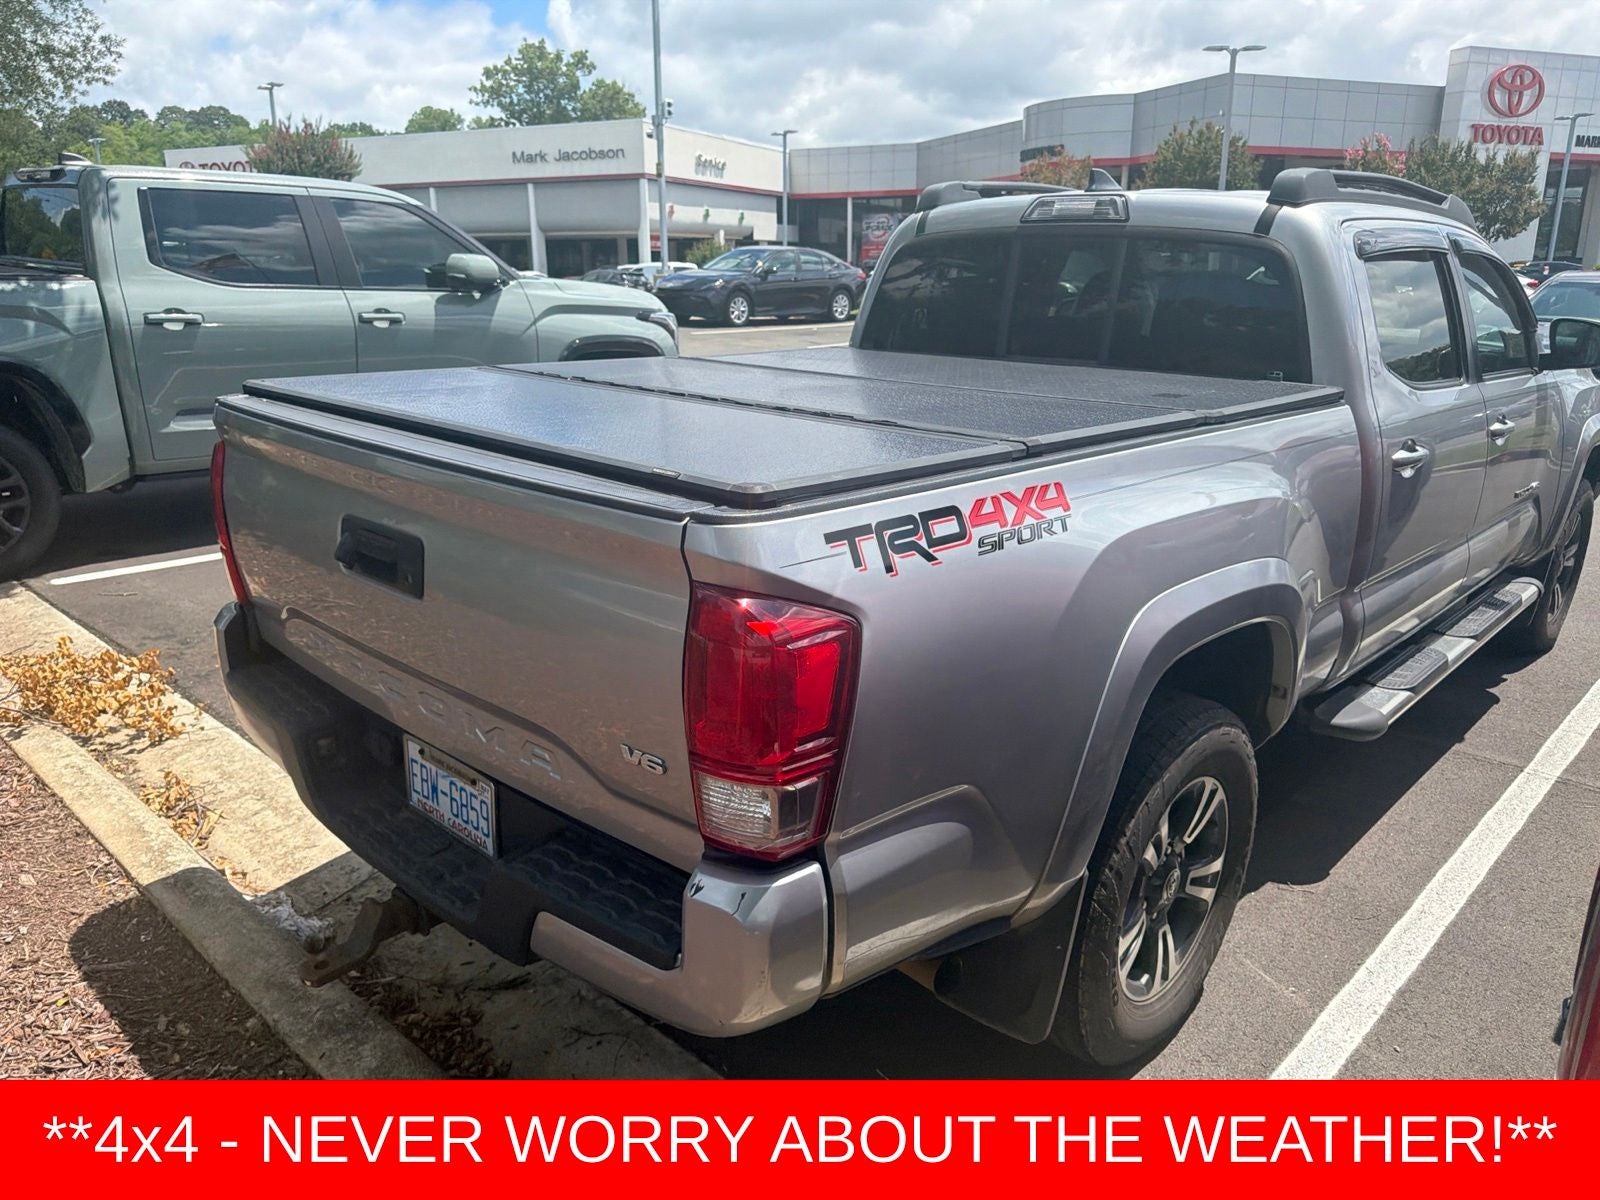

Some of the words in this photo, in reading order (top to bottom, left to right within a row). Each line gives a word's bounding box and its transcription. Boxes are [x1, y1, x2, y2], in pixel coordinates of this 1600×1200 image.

[1471, 123, 1544, 145] TOYOTA
[198, 161, 253, 172] TOYOT
[512, 150, 548, 163] Mark
[554, 147, 625, 162] Jacobson
[823, 505, 973, 577] TRD
[968, 481, 1072, 529] 4X4
[977, 514, 1072, 557] SPORT
[620, 743, 667, 775] V6
[410, 758, 490, 838] EBW-6859
[416, 798, 446, 824] NORTH
[447, 818, 489, 851] CAROLINA
